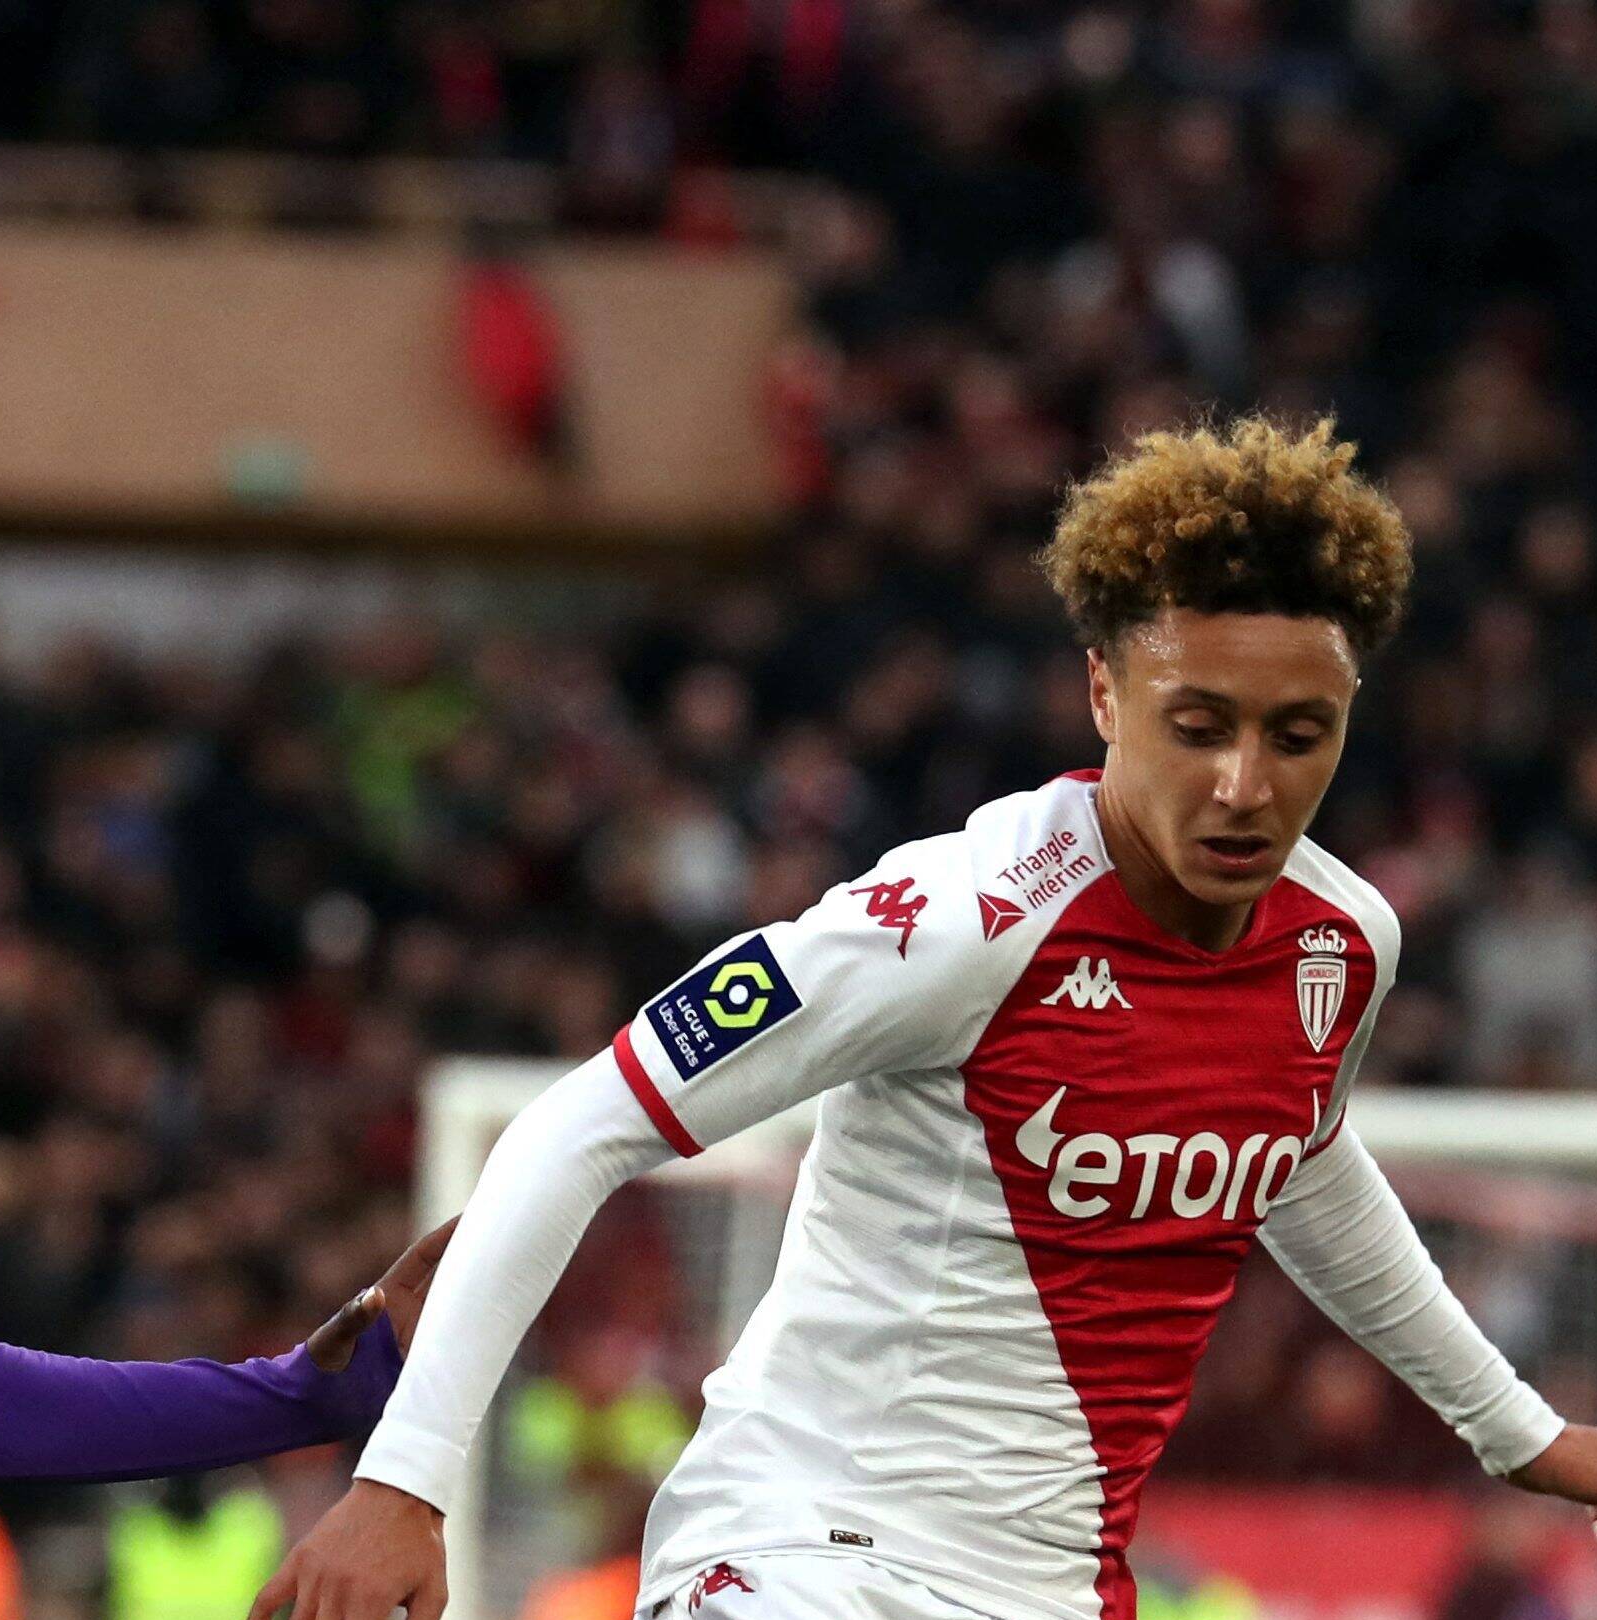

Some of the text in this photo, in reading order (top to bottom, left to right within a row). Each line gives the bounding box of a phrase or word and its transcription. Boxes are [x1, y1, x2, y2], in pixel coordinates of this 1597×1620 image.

[995, 830, 1078, 885] Triangle
[1023, 854, 1096, 910] intérim
[658, 1001, 700, 1068] Uber Eats
[676, 994, 716, 1053] LIGUE 1
